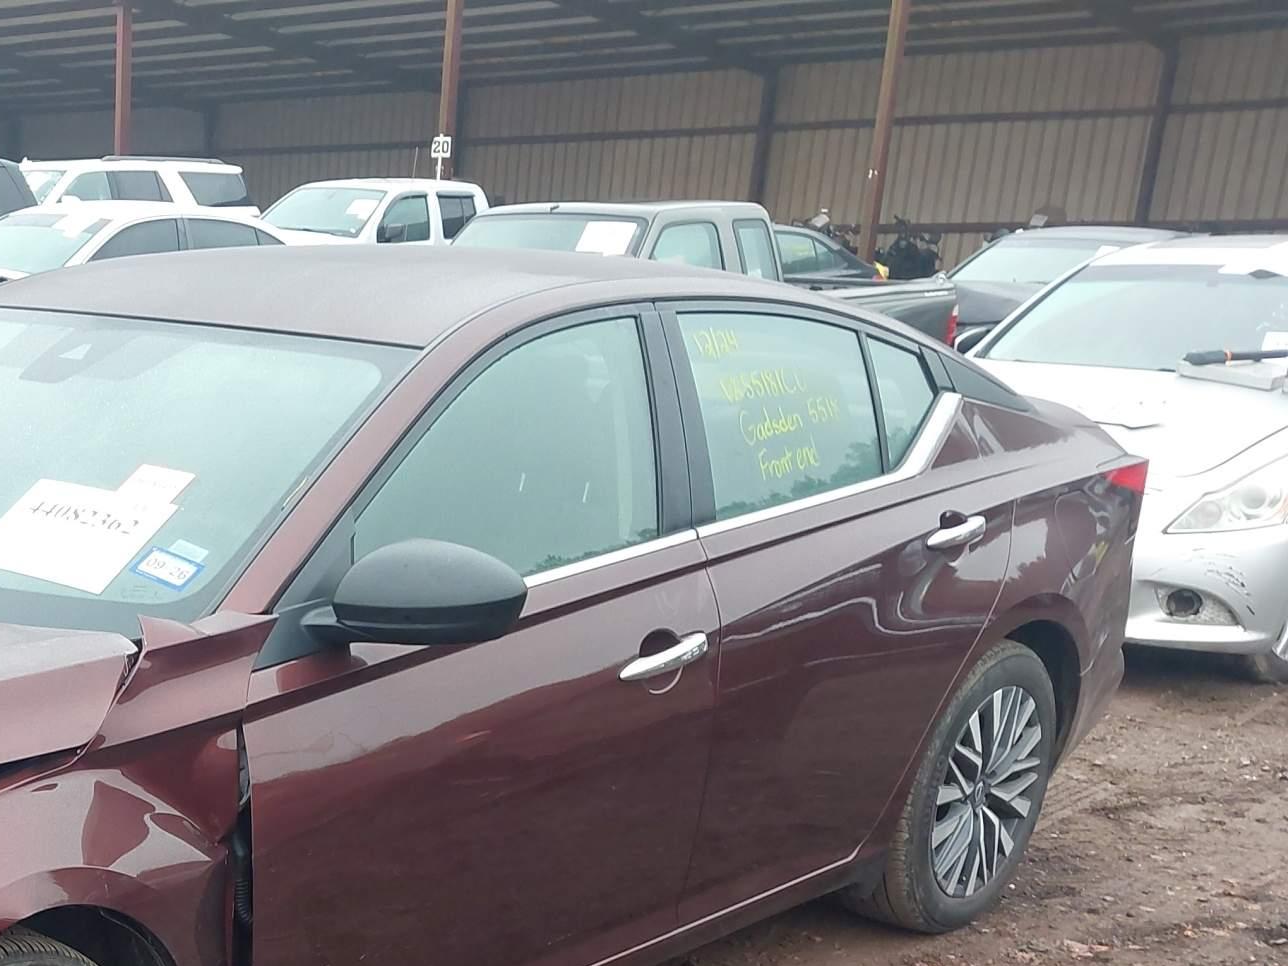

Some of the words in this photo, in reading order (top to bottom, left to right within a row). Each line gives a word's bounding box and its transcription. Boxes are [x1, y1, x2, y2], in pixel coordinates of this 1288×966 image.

[433, 140, 449, 153] 20
[738, 406, 804, 446] Gadsden
[758, 446, 793, 481] Front
[796, 432, 820, 470] end
[30, 501, 140, 535] 44082362
